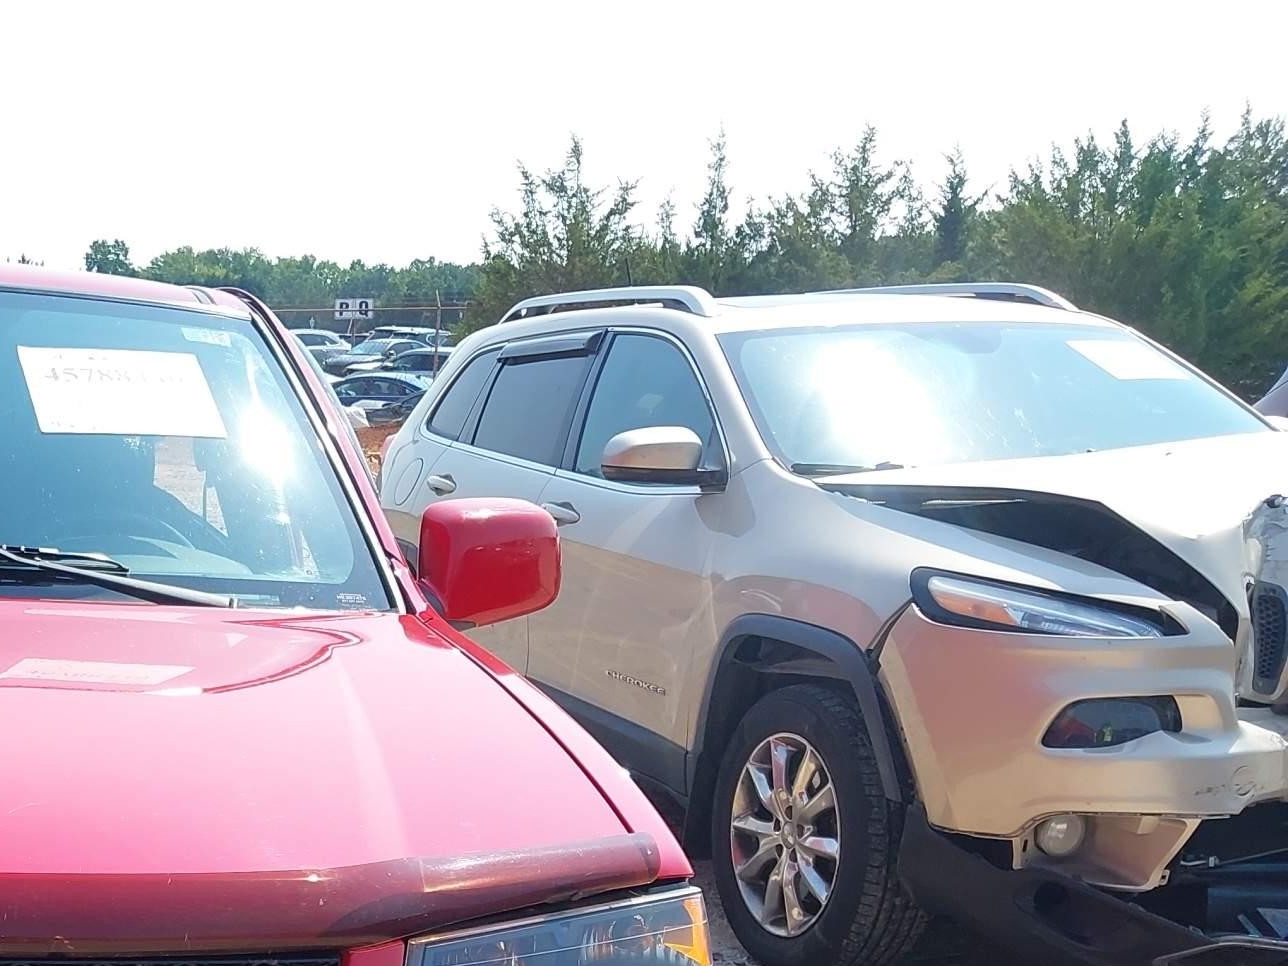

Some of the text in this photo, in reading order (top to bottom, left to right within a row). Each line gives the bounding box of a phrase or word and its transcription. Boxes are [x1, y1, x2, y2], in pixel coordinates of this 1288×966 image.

[339, 300, 369, 317] P Q
[605, 669, 667, 696] CHEROKEE
